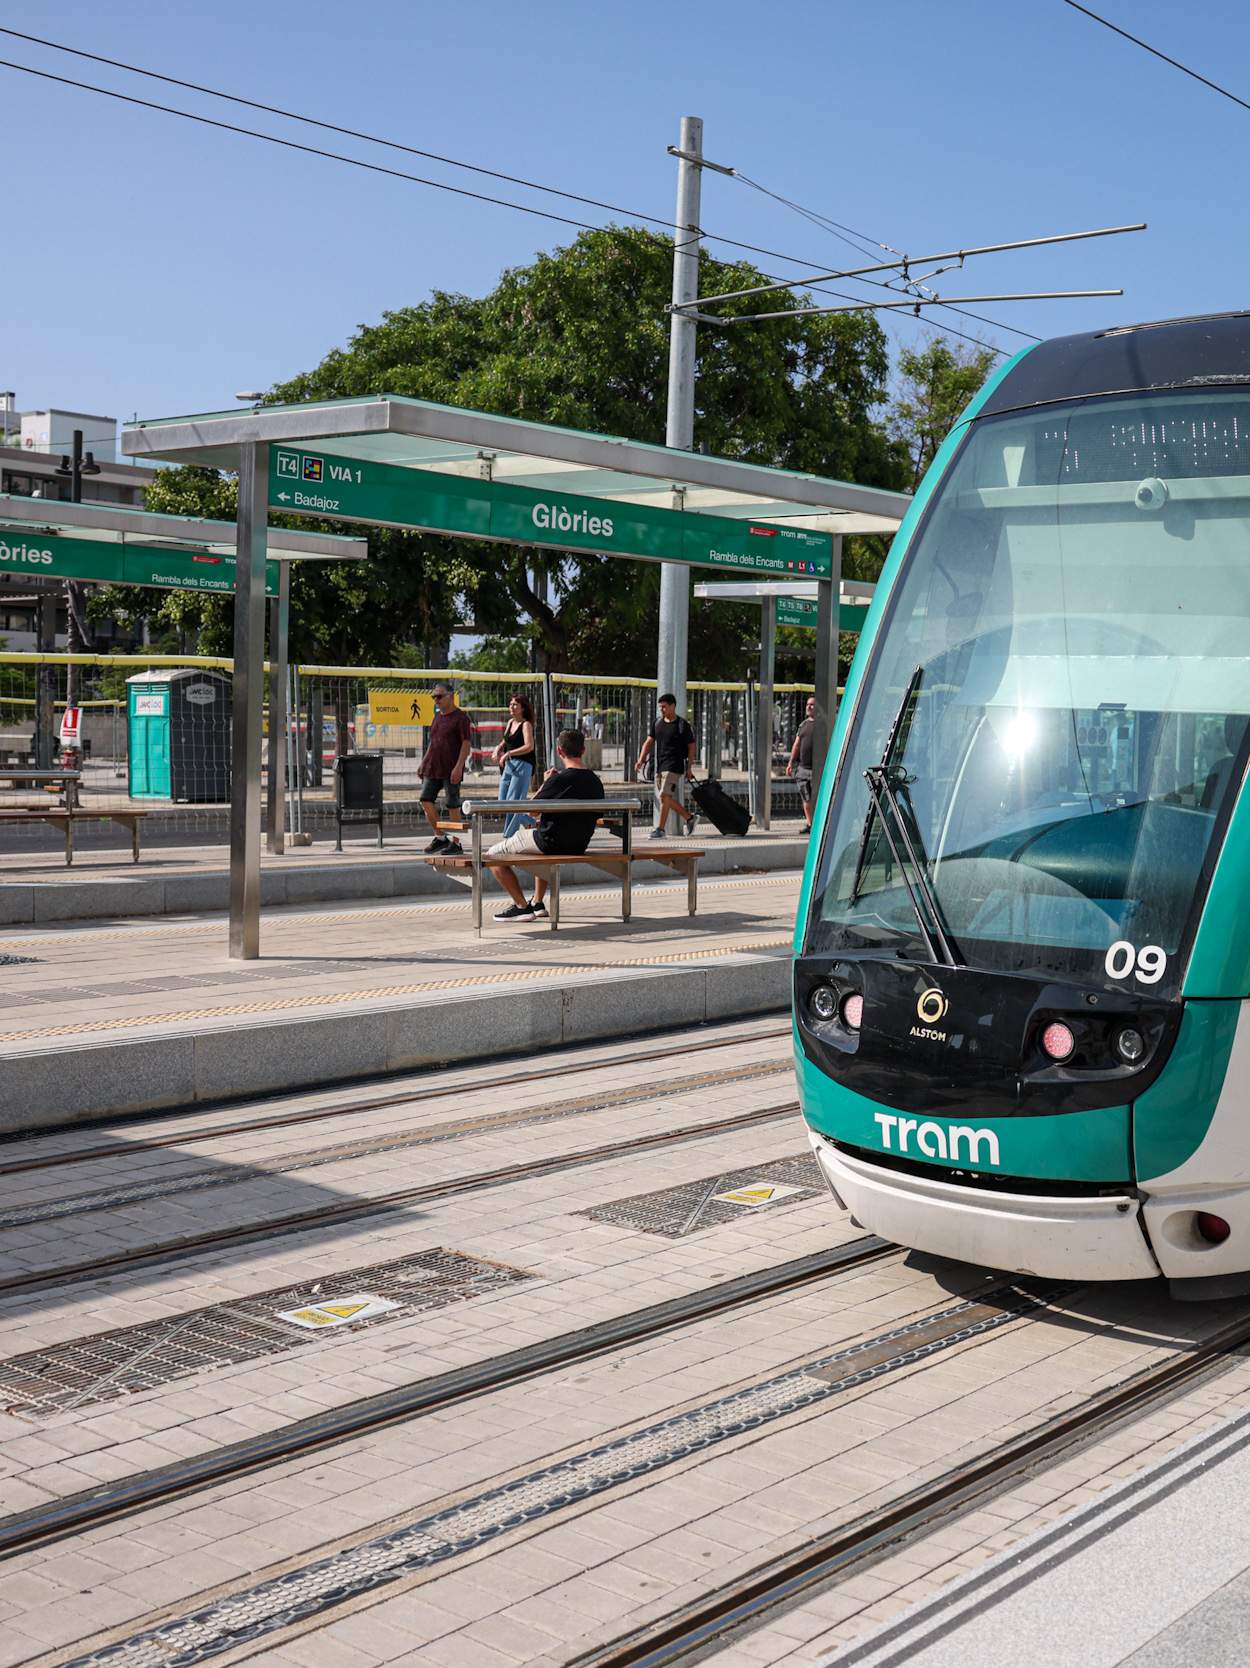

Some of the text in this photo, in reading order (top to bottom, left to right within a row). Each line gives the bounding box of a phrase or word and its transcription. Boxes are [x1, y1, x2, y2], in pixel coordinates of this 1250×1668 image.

[280, 457, 362, 483] T4 VIA 1
[294, 492, 340, 511] Badajoz
[532, 503, 614, 537] Glòries
[709, 550, 739, 562] Rambla
[739, 553, 755, 565] dels
[755, 555, 784, 569] Encants
[152, 573, 229, 589] Rambla dels Encants
[1105, 940, 1167, 985] 09
[909, 1026, 947, 1042] ALSTOM
